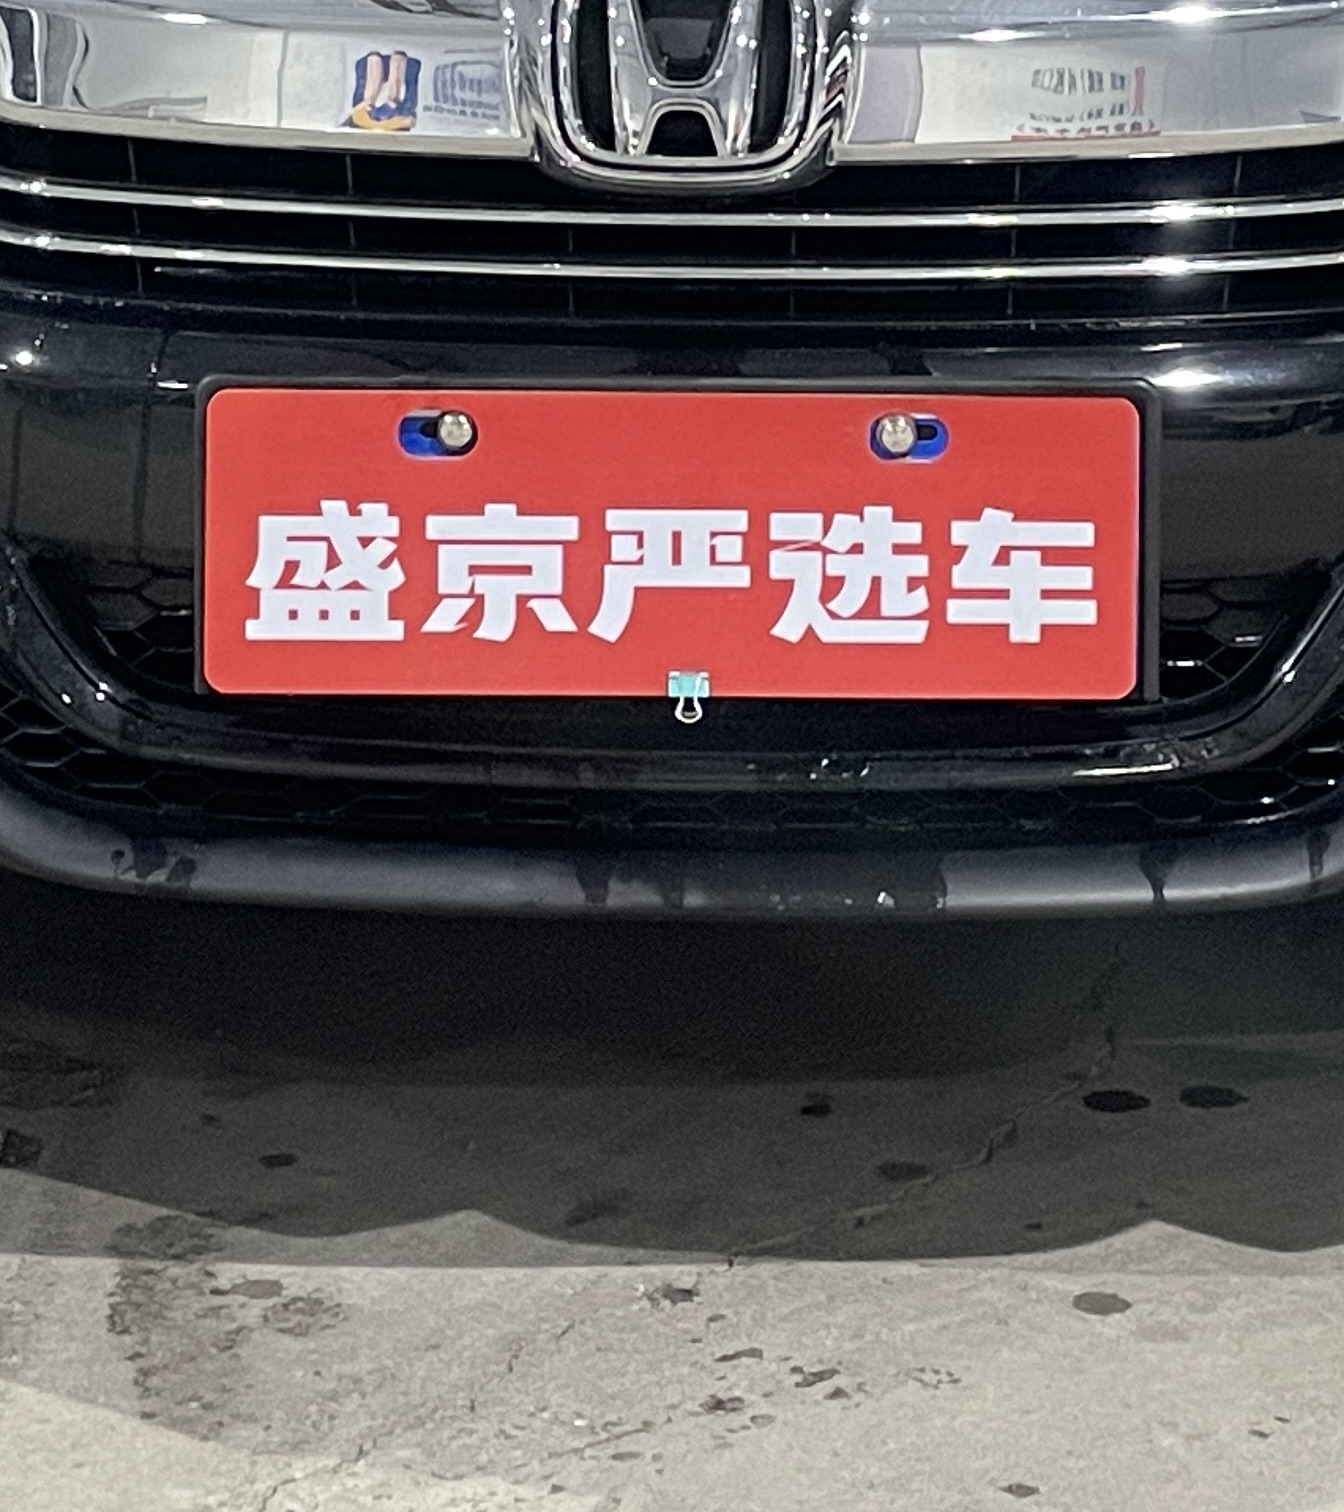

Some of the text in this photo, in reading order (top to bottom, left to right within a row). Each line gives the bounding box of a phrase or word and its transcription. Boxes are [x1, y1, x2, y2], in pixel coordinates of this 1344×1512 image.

[244, 498, 1099, 645] 盛京严选车
